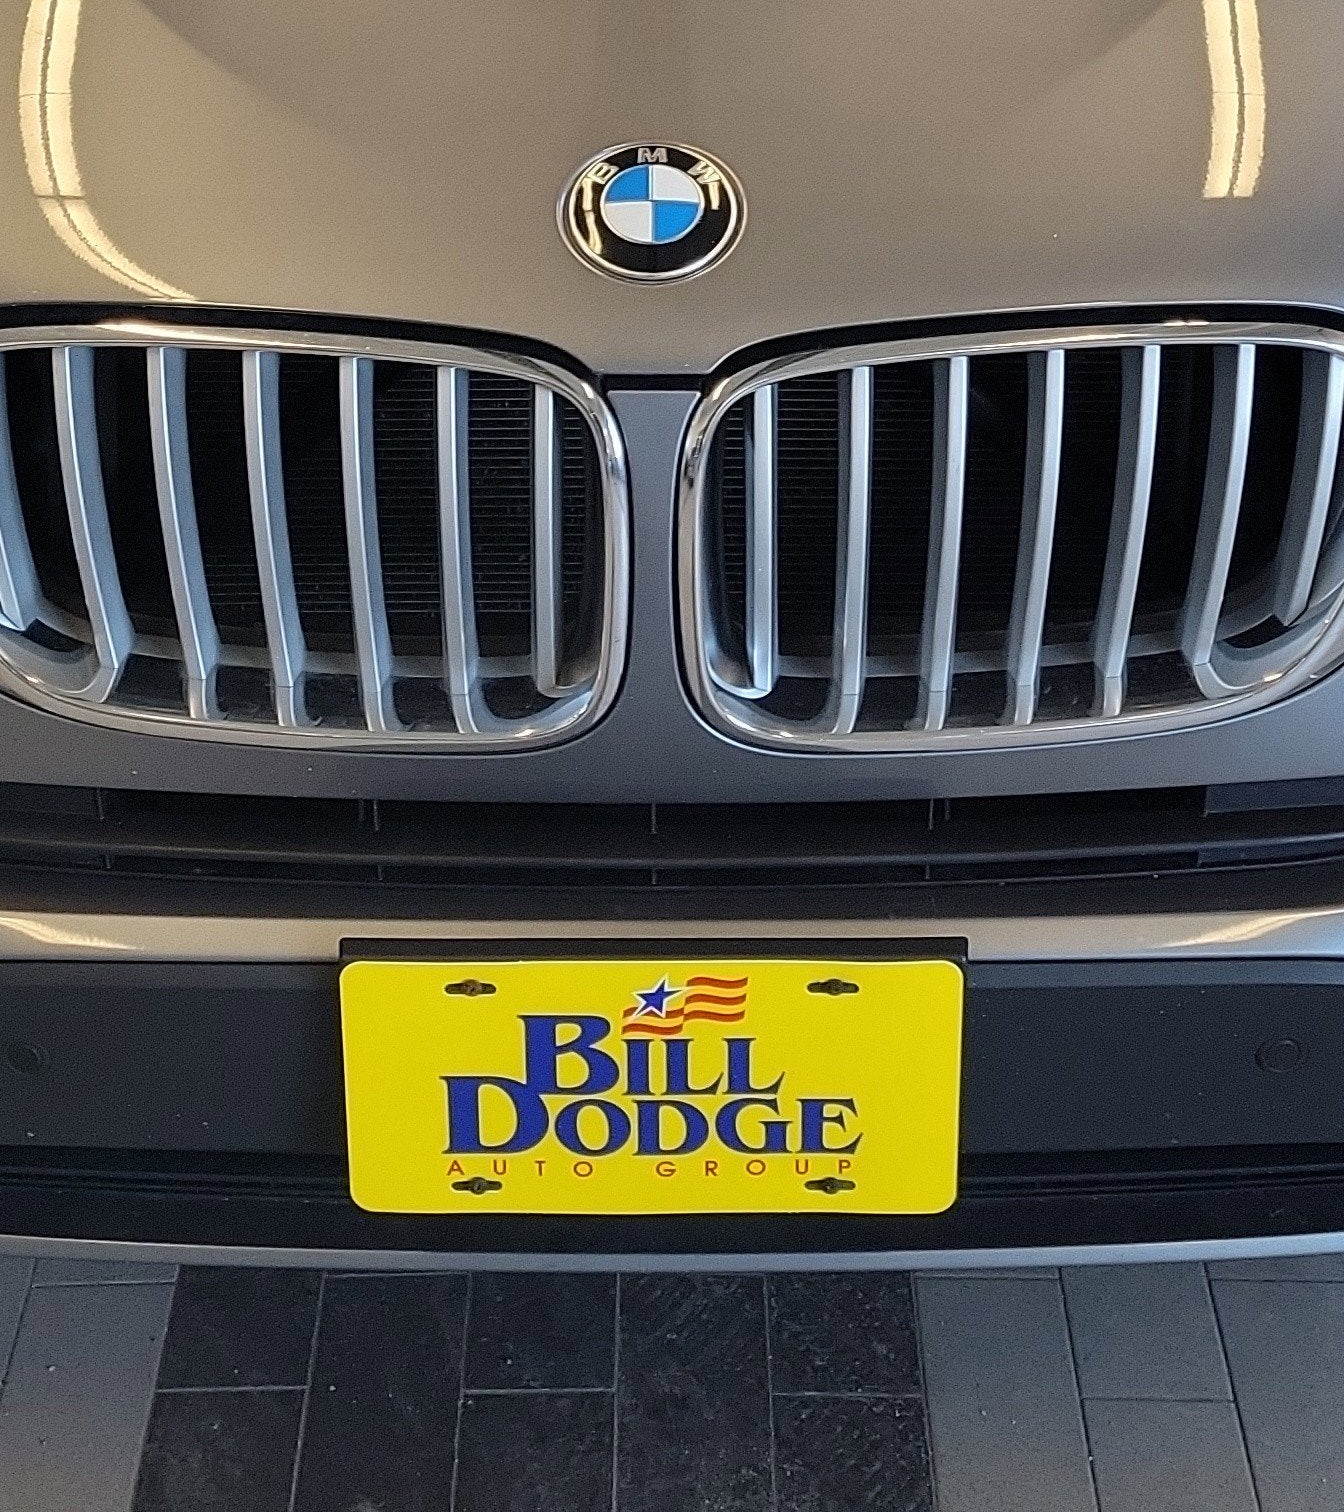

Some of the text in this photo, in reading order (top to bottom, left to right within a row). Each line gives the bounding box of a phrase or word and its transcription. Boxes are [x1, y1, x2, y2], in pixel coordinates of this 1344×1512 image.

[586, 147, 722, 184] BMW
[517, 1014, 786, 1095] BILL
[439, 1075, 863, 1156] DODGE
[446, 1160, 851, 1178] AUTO GROUP
